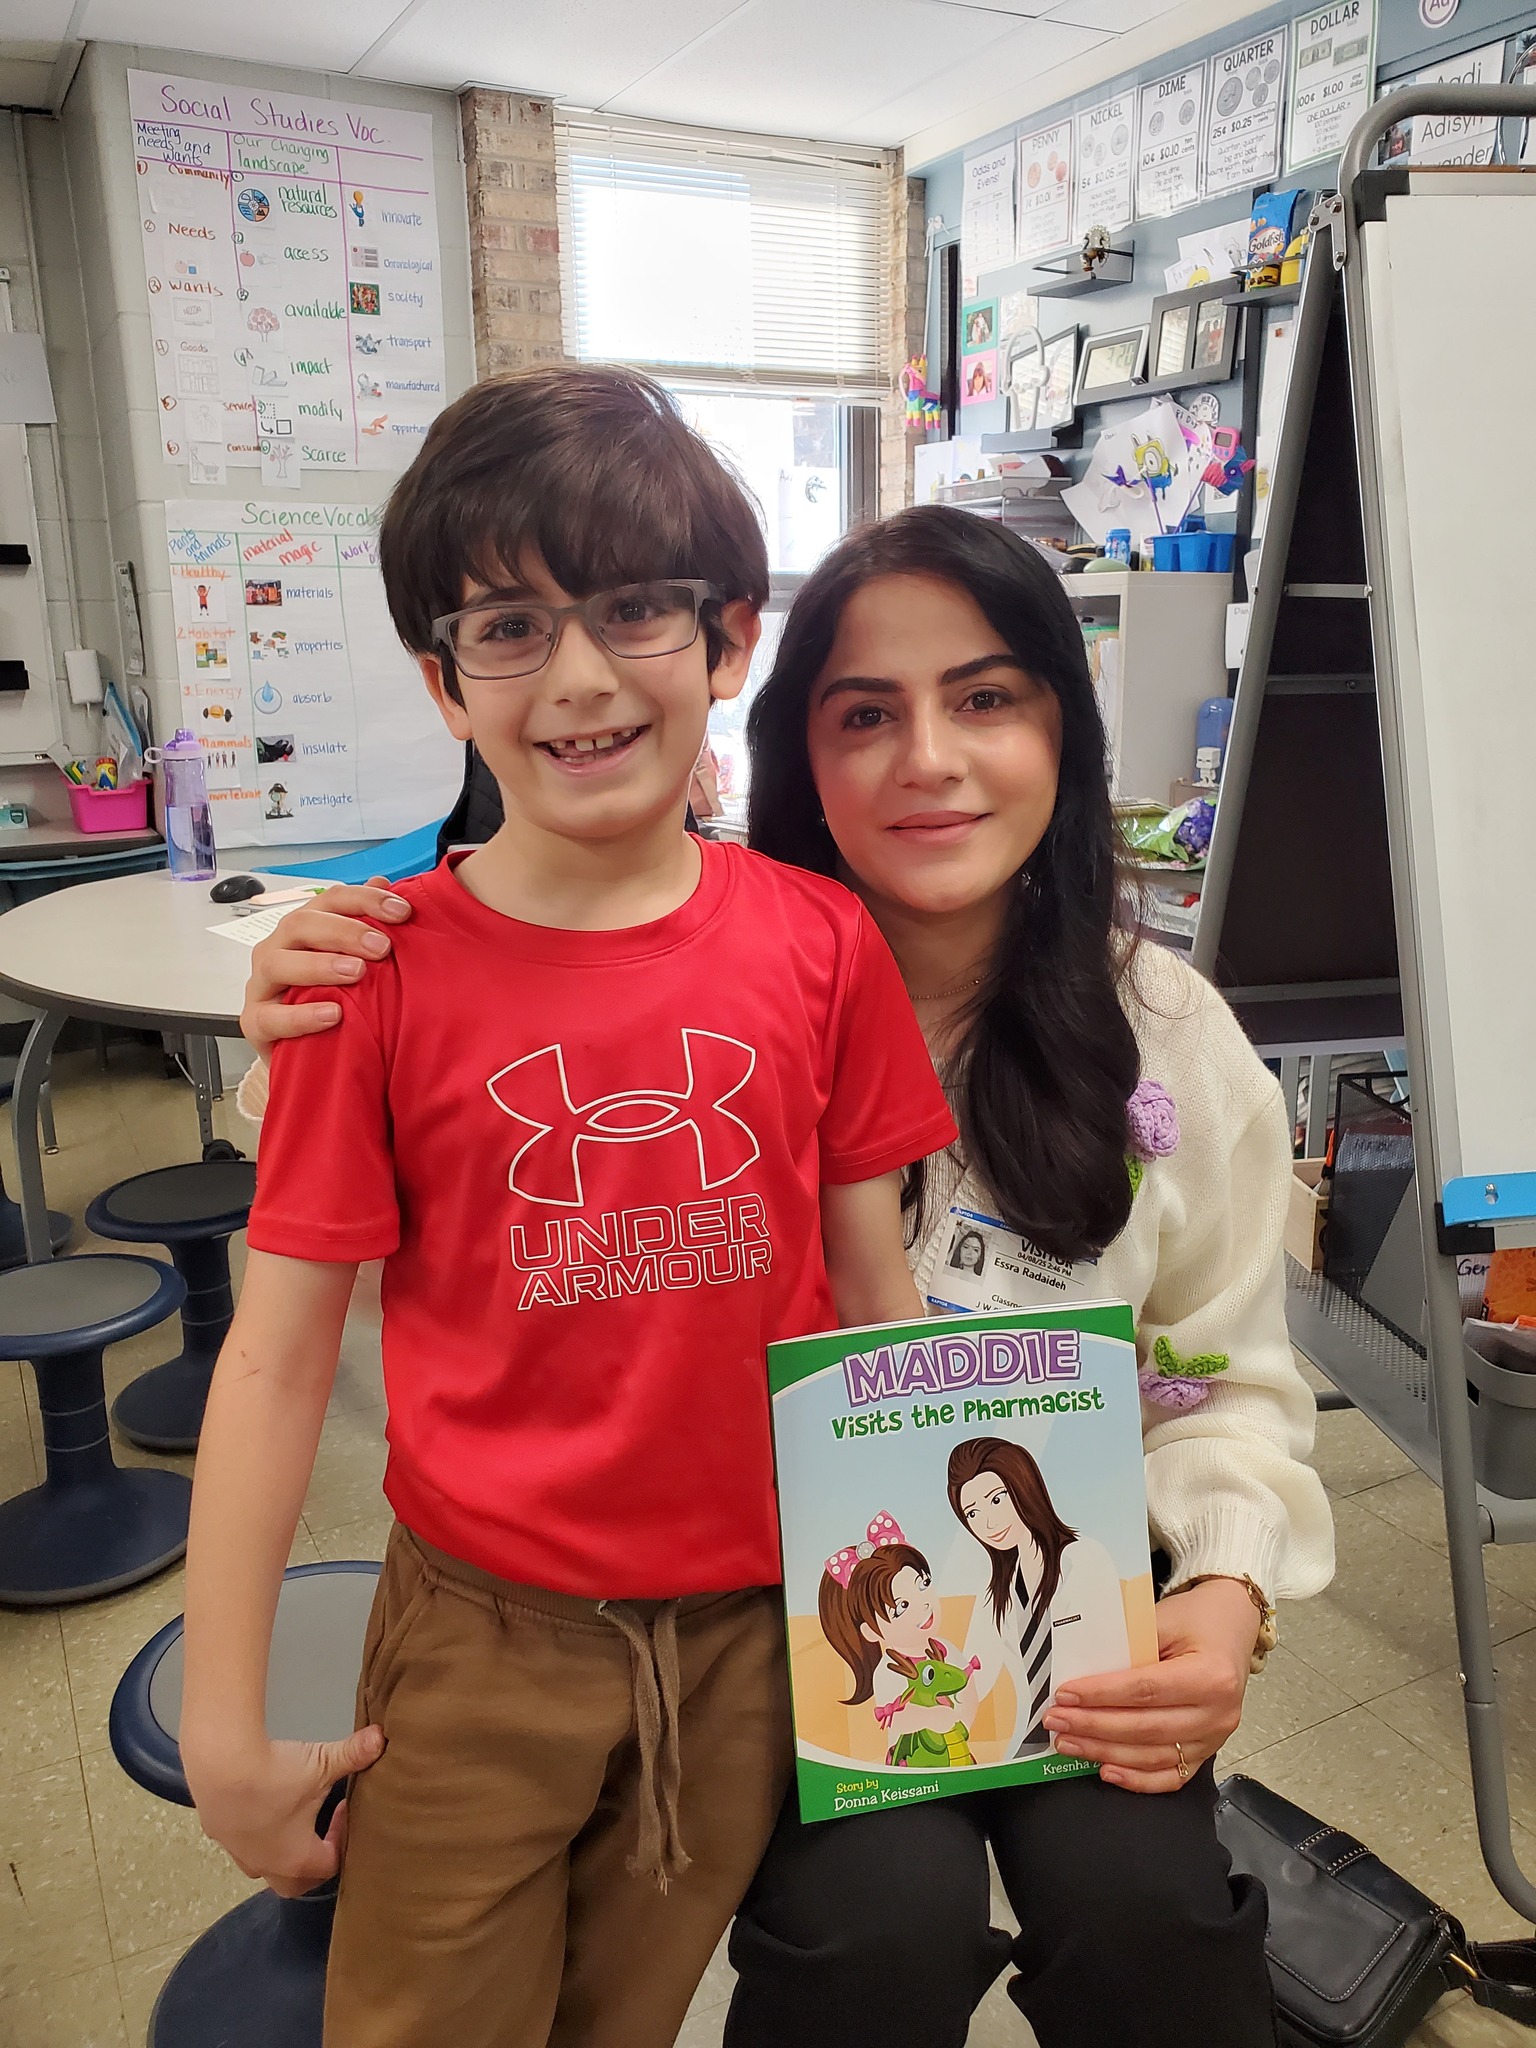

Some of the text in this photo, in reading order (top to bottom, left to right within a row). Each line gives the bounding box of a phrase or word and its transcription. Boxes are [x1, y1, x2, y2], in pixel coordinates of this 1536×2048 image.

[1311, 1, 1359, 35] DOLLAR
[1223, 39, 1273, 72] QUARTER
[1158, 75, 1187, 99] DIME
[1323, 81, 1343, 98] $1.00
[161, 84, 231, 122] Social
[250, 98, 339, 136] Studies
[1090, 103, 1123, 128] NICKEL
[1320, 101, 1346, 118] DOLLAR
[137, 122, 181, 144] Meeting
[1212, 126, 1227, 139] 25¢
[1231, 116, 1252, 132] $0.25
[138, 136, 211, 155] needs and
[233, 133, 329, 164] Our Changing
[1032, 129, 1060, 151] PENNY
[163, 151, 203, 166] wants
[238, 149, 309, 176] landscape
[992, 155, 1006, 170] and
[1143, 153, 1155, 166] 10¢
[1160, 143, 1179, 160] $0.10
[278, 182, 327, 205] natural
[282, 199, 337, 218] resources
[168, 222, 216, 240] Needs
[1250, 229, 1285, 253] Goldfish
[284, 246, 328, 261] access
[168, 280, 223, 297] Wants
[284, 299, 347, 319] available
[387, 292, 424, 308] society
[180, 341, 209, 353] Goods
[386, 334, 431, 351] transport
[290, 358, 332, 376] impact
[386, 380, 440, 392] manufactured
[298, 399, 343, 421] modify
[301, 445, 347, 462] Scarce
[241, 502, 323, 526] Science
[168, 528, 196, 556] Plants
[185, 538, 202, 557] and
[193, 533, 232, 565] Animals
[181, 564, 226, 581] Healthy
[285, 586, 334, 600] materials
[187, 627, 237, 640] Habitat
[295, 639, 344, 653] properties
[195, 683, 243, 700] Energy
[292, 691, 332, 704] absorb
[302, 741, 349, 756] insulate
[207, 788, 263, 801] nvertebrate
[300, 793, 353, 808] investigate
[510, 1192, 770, 1272] UNDER
[994, 1257, 1067, 1291] Essra Radaideh
[1017, 1252, 1072, 1278] 04/08/25 2:46 PM
[517, 1239, 772, 1311] ARMOUR
[842, 1328, 1081, 1407] MADDIE
[831, 1386, 1106, 1440] Visits the Pharmacist
[1043, 1759, 1090, 1776] Kresnha
[836, 1777, 879, 1794] Story by
[834, 1780, 940, 1812] Donna Keissami
